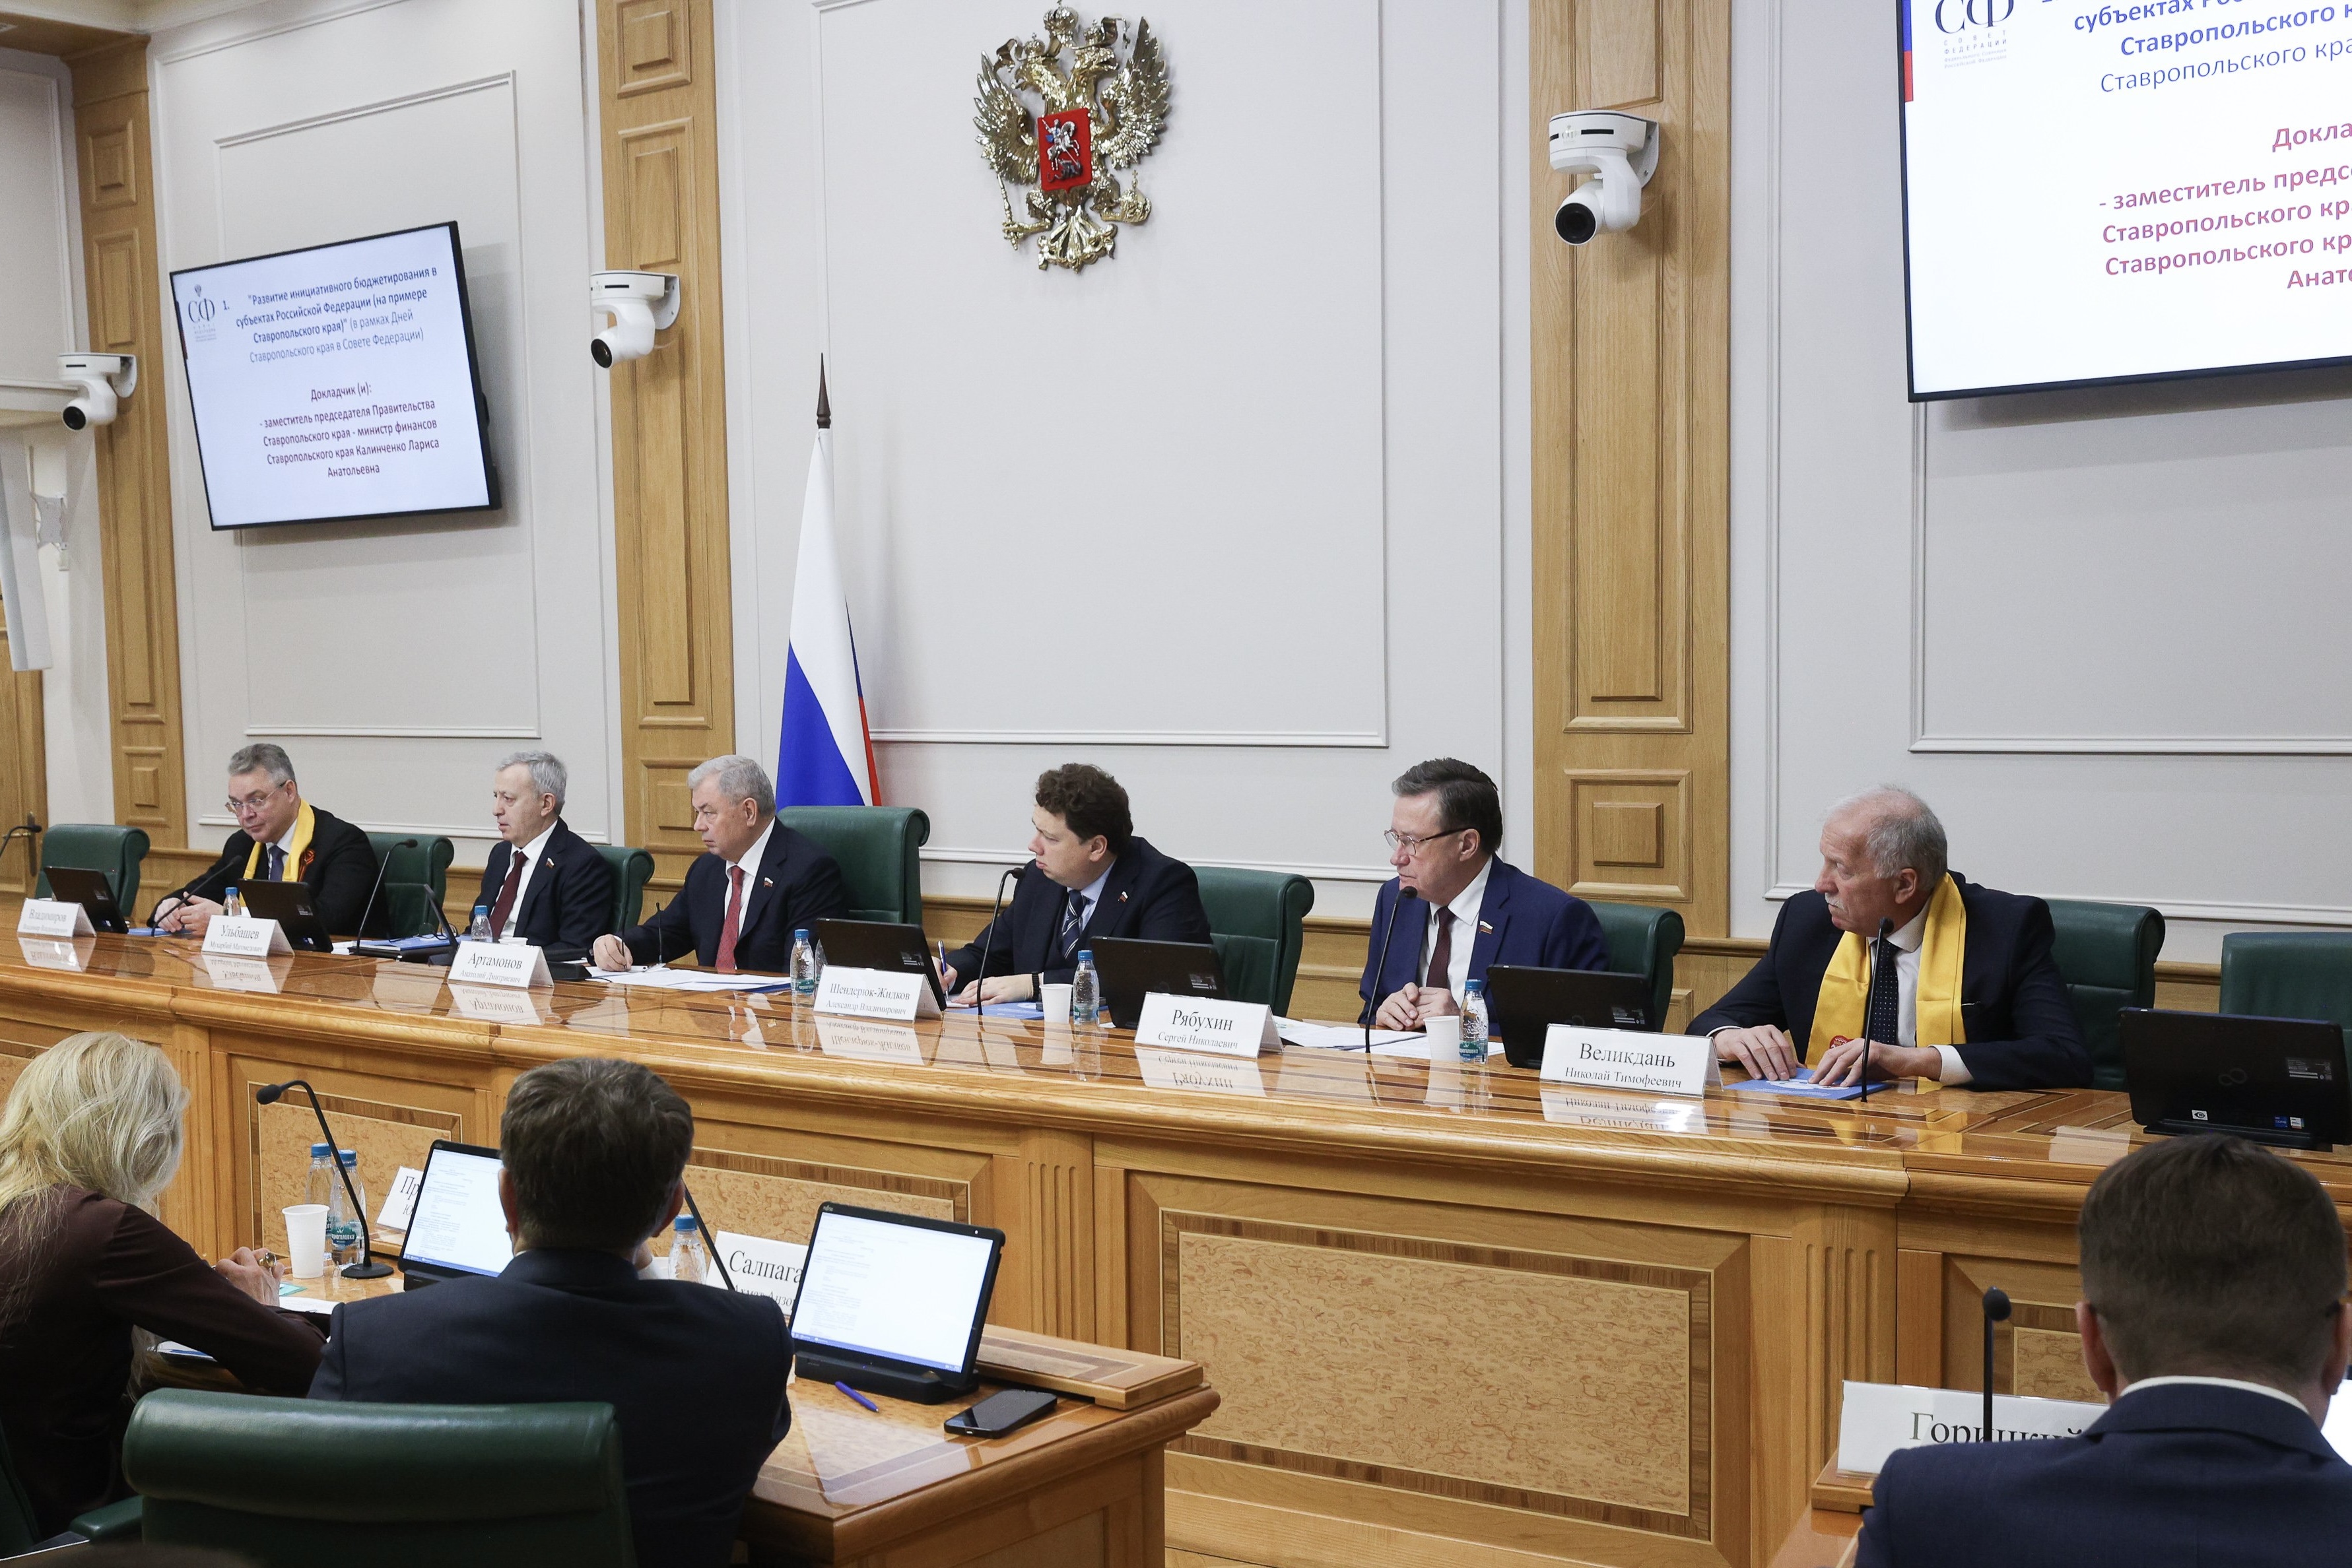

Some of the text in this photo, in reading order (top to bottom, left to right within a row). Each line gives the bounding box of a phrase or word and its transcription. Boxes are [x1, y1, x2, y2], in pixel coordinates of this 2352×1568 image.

[2074, 0, 2194, 33] субъектах
[2121, 7, 2335, 55] Ставропольского
[1944, 39, 2006, 54] ФЕДЕРАЦИИ
[2100, 47, 2306, 92] Ставропольского
[2272, 123, 2352, 152] Докла
[2114, 178, 2266, 209] заместитель
[2274, 165, 2352, 191] предс
[2103, 200, 2352, 243] Ставропольского кр
[2106, 239, 2314, 275] Ставропольского
[290, 282, 352, 298] инициативного
[354, 269, 430, 289] бюджетирования
[188, 298, 215, 323] СФ
[236, 289, 427, 329] субъектах Российской Федерации (на примере
[253, 325, 320, 343] Ставропольского
[360, 315, 389, 329] рамках
[391, 309, 413, 325] Дней
[250, 345, 315, 363] Ставропольского
[316, 343, 334, 355] края
[343, 338, 370, 350] Совете
[372, 327, 424, 345] Федерации)
[311, 386, 356, 402] Докладчик
[264, 415, 313, 428] заместитель
[314, 408, 370, 424] председателя
[372, 400, 435, 417] Правительства
[263, 432, 329, 447] Ставропольского
[331, 430, 351, 441] края
[357, 424, 393, 436] министр
[395, 419, 437, 434] финансов
[267, 439, 440, 465] Ставропольского края Калинченко Лариса
[327, 464, 380, 478] Анатольевна
[220, 925, 260, 940] Ульбашев
[468, 952, 523, 969] Артамонов
[830, 983, 910, 1000] Шендерюк-Жидков
[825, 1000, 907, 1015] Александр Владимирович
[1172, 1009, 1233, 1032] Рябухин
[1158, 1031, 1238, 1049] Сергей Николаевич
[1580, 1043, 1676, 1068] Великдань
[1565, 1067, 1682, 1088] Николай Тимофеевич
[729, 1250, 803, 1284] Салпага
